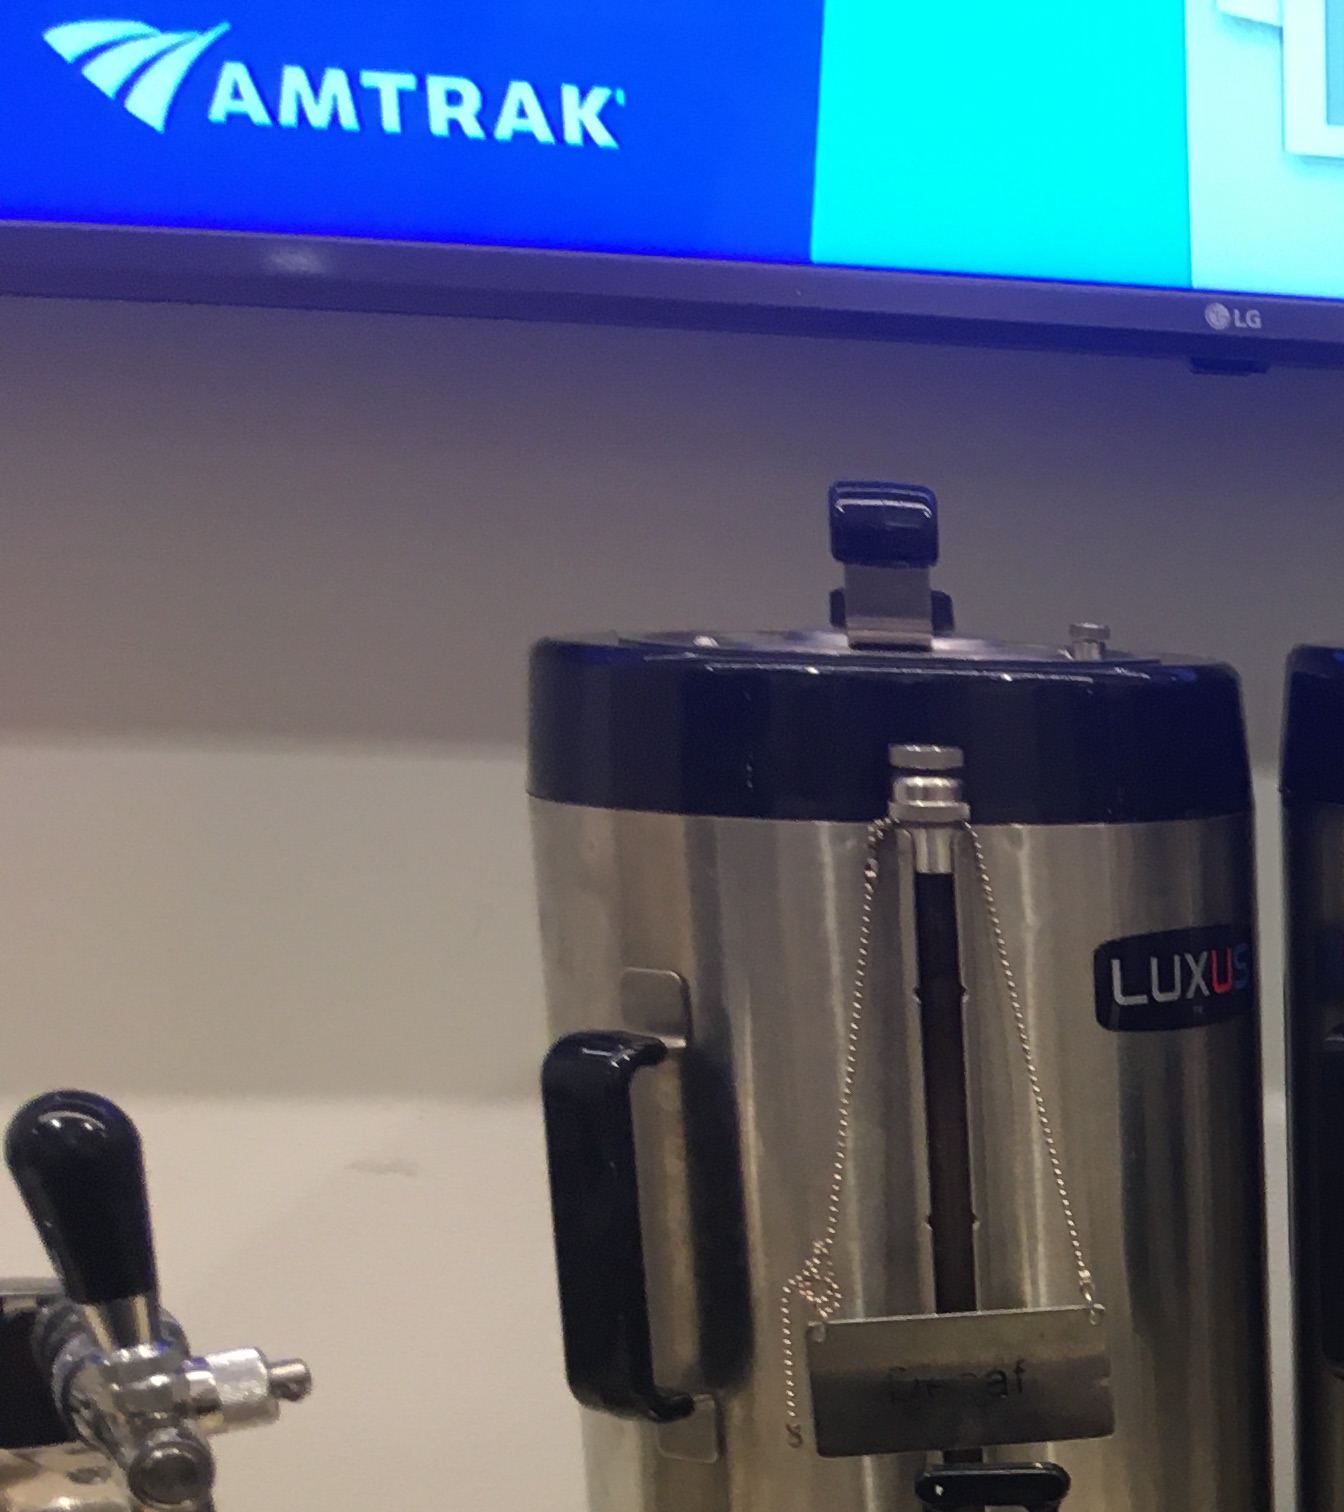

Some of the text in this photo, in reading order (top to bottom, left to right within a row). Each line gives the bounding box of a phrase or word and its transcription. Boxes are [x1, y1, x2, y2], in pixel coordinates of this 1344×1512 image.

[208, 61, 619, 149] AMTRAK
[1233, 308, 1262, 329] LG
[1111, 943, 1249, 1006] LUXUS
